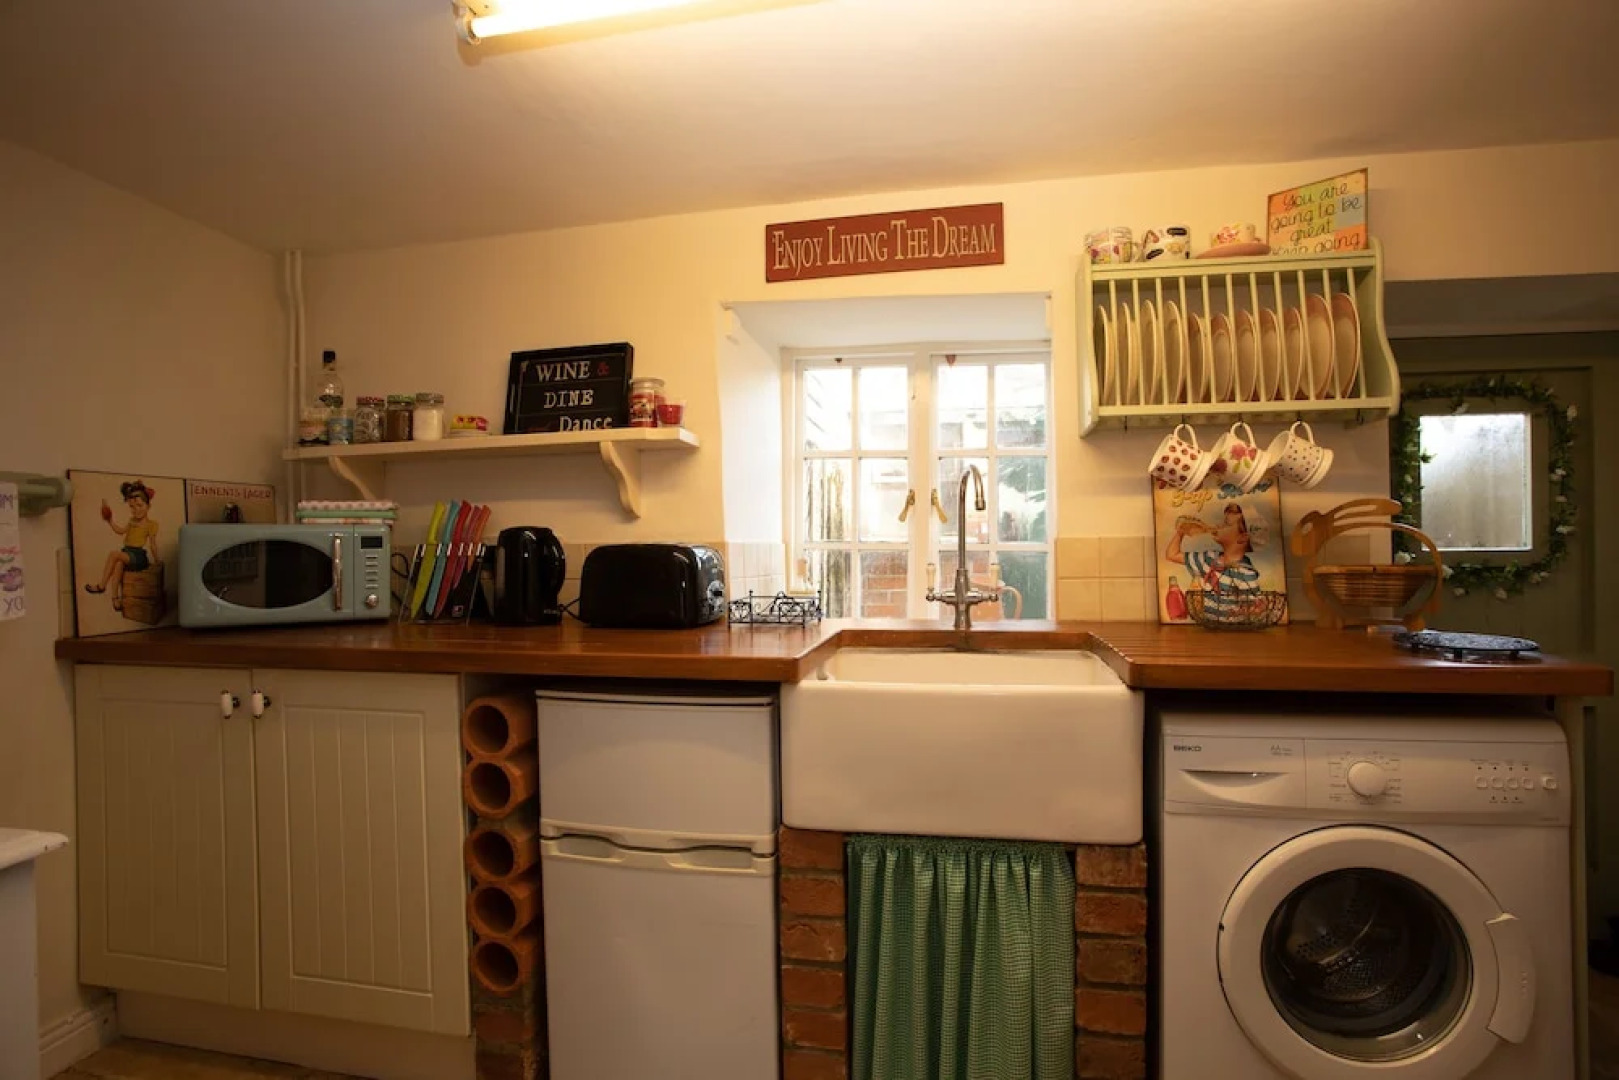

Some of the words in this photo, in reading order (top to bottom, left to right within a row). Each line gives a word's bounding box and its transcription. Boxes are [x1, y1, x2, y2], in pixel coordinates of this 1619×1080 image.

[1320, 183, 1348, 200] are
[1271, 210, 1313, 233] going
[1319, 201, 1335, 218] to
[1341, 197, 1361, 212] be
[1290, 219, 1330, 246] great
[773, 229, 823, 276] ENJOY
[827, 226, 887, 264] LIVING
[891, 219, 929, 259] THE
[932, 216, 995, 258] DREAM
[536, 360, 591, 382] WINE
[597, 361, 609, 375] &
[544, 389, 594, 409] DINE
[559, 416, 613, 432] Dance
